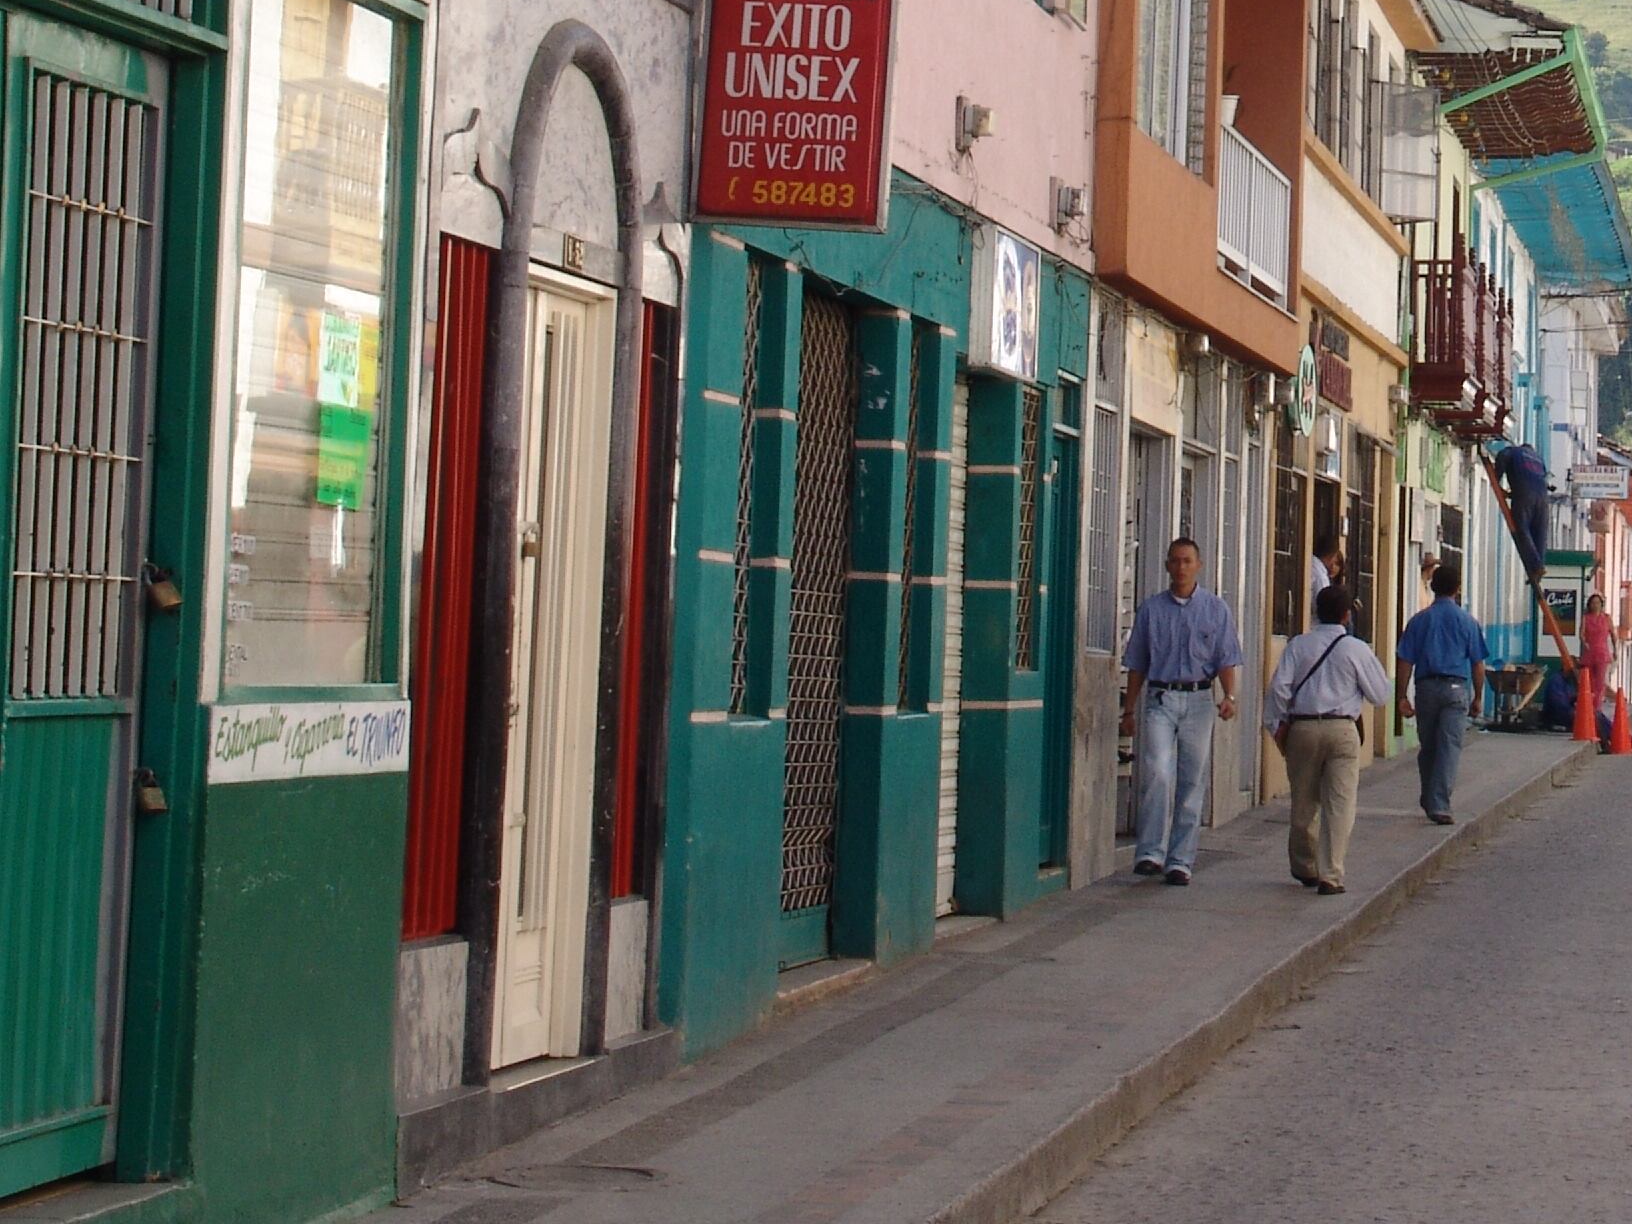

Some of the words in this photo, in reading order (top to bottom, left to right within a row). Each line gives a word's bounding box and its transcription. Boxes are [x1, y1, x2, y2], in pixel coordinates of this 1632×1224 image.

[740, 1, 852, 51] EXITO
[724, 52, 861, 103] UNISEX
[721, 109, 767, 137] UNA
[772, 112, 857, 141] FORMA
[728, 141, 757, 168] DE
[764, 143, 846, 172] VESTIR
[752, 180, 856, 207] 587483
